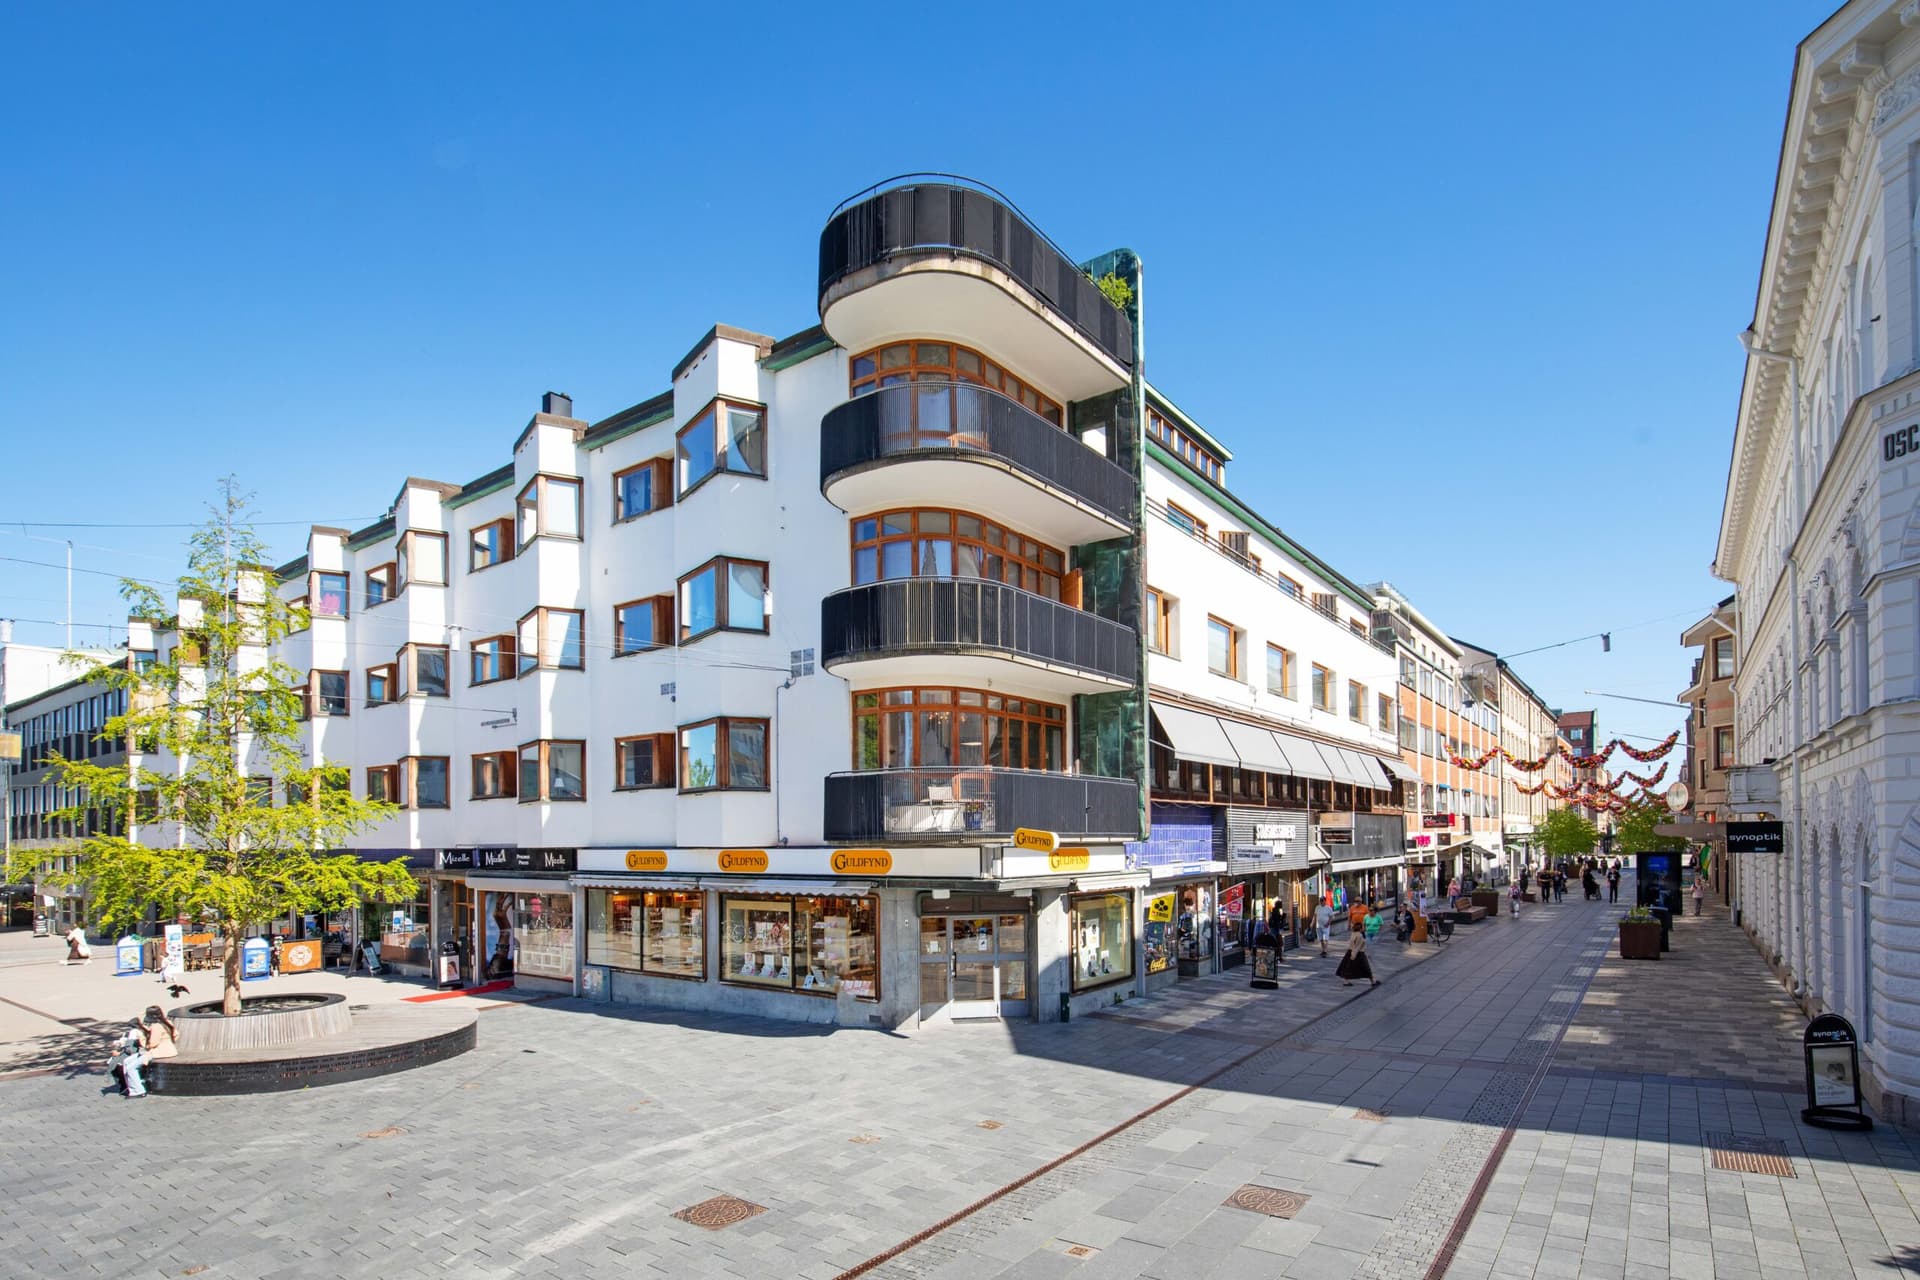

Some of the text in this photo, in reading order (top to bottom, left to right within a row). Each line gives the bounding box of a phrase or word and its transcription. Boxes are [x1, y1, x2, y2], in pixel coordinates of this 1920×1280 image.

[1017, 832, 1051, 847] GULDFYND
[1729, 832, 1781, 842] synoptik
[628, 853, 665, 867] GULDFYND
[721, 854, 766, 869] GULDFYND
[834, 854, 889, 870] GULDFYND
[1051, 853, 1088, 869] GULDFYND
